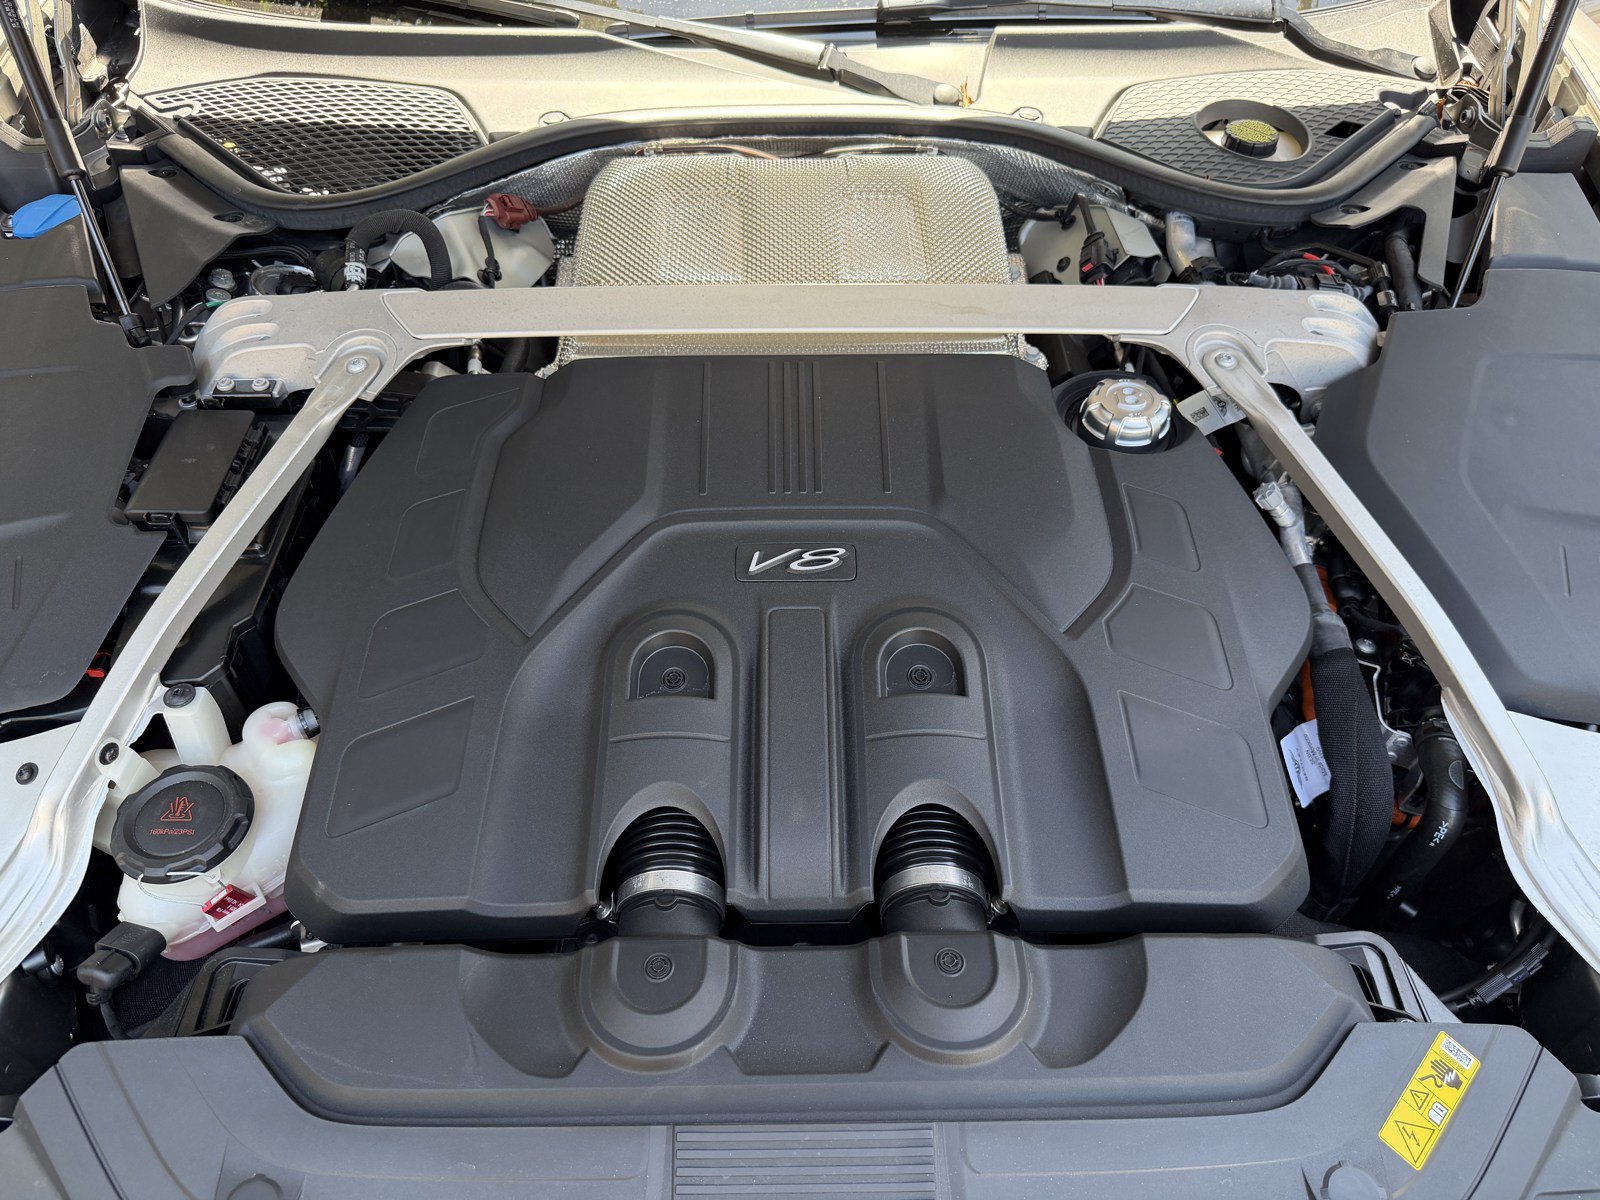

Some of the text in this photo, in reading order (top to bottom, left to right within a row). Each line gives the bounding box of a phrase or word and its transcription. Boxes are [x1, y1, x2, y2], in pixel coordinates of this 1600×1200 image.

[748, 547, 847, 573] V8
[1304, 734, 1316, 756] Morocco
[1318, 762, 1328, 777] Made
[149, 828, 195, 836] 160kPa/23PSI
